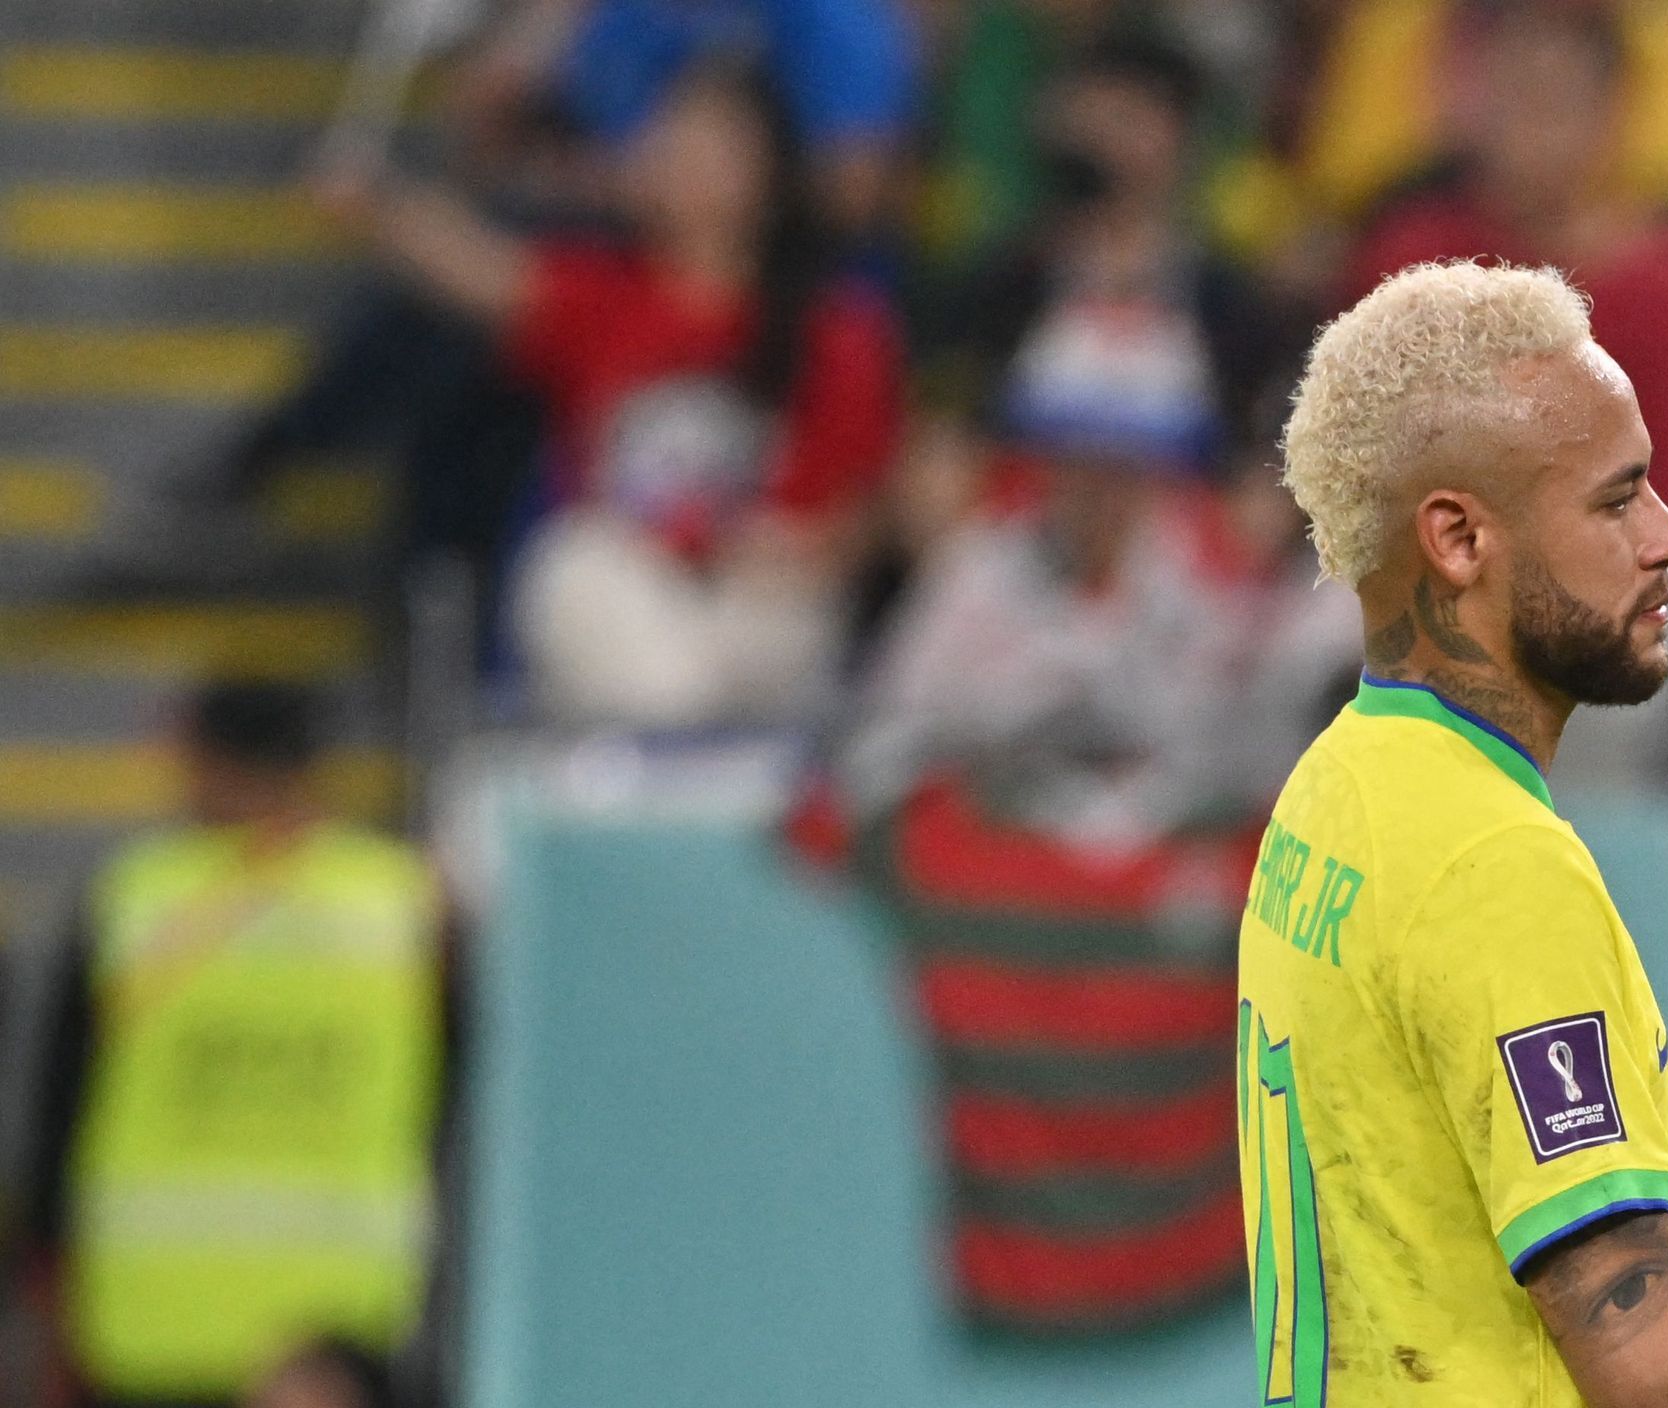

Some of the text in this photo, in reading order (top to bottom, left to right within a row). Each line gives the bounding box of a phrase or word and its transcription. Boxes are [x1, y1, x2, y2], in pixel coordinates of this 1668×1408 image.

[1292, 855, 1366, 968] JR
[1545, 1103, 1605, 1126] FIFA WORLD CUP
